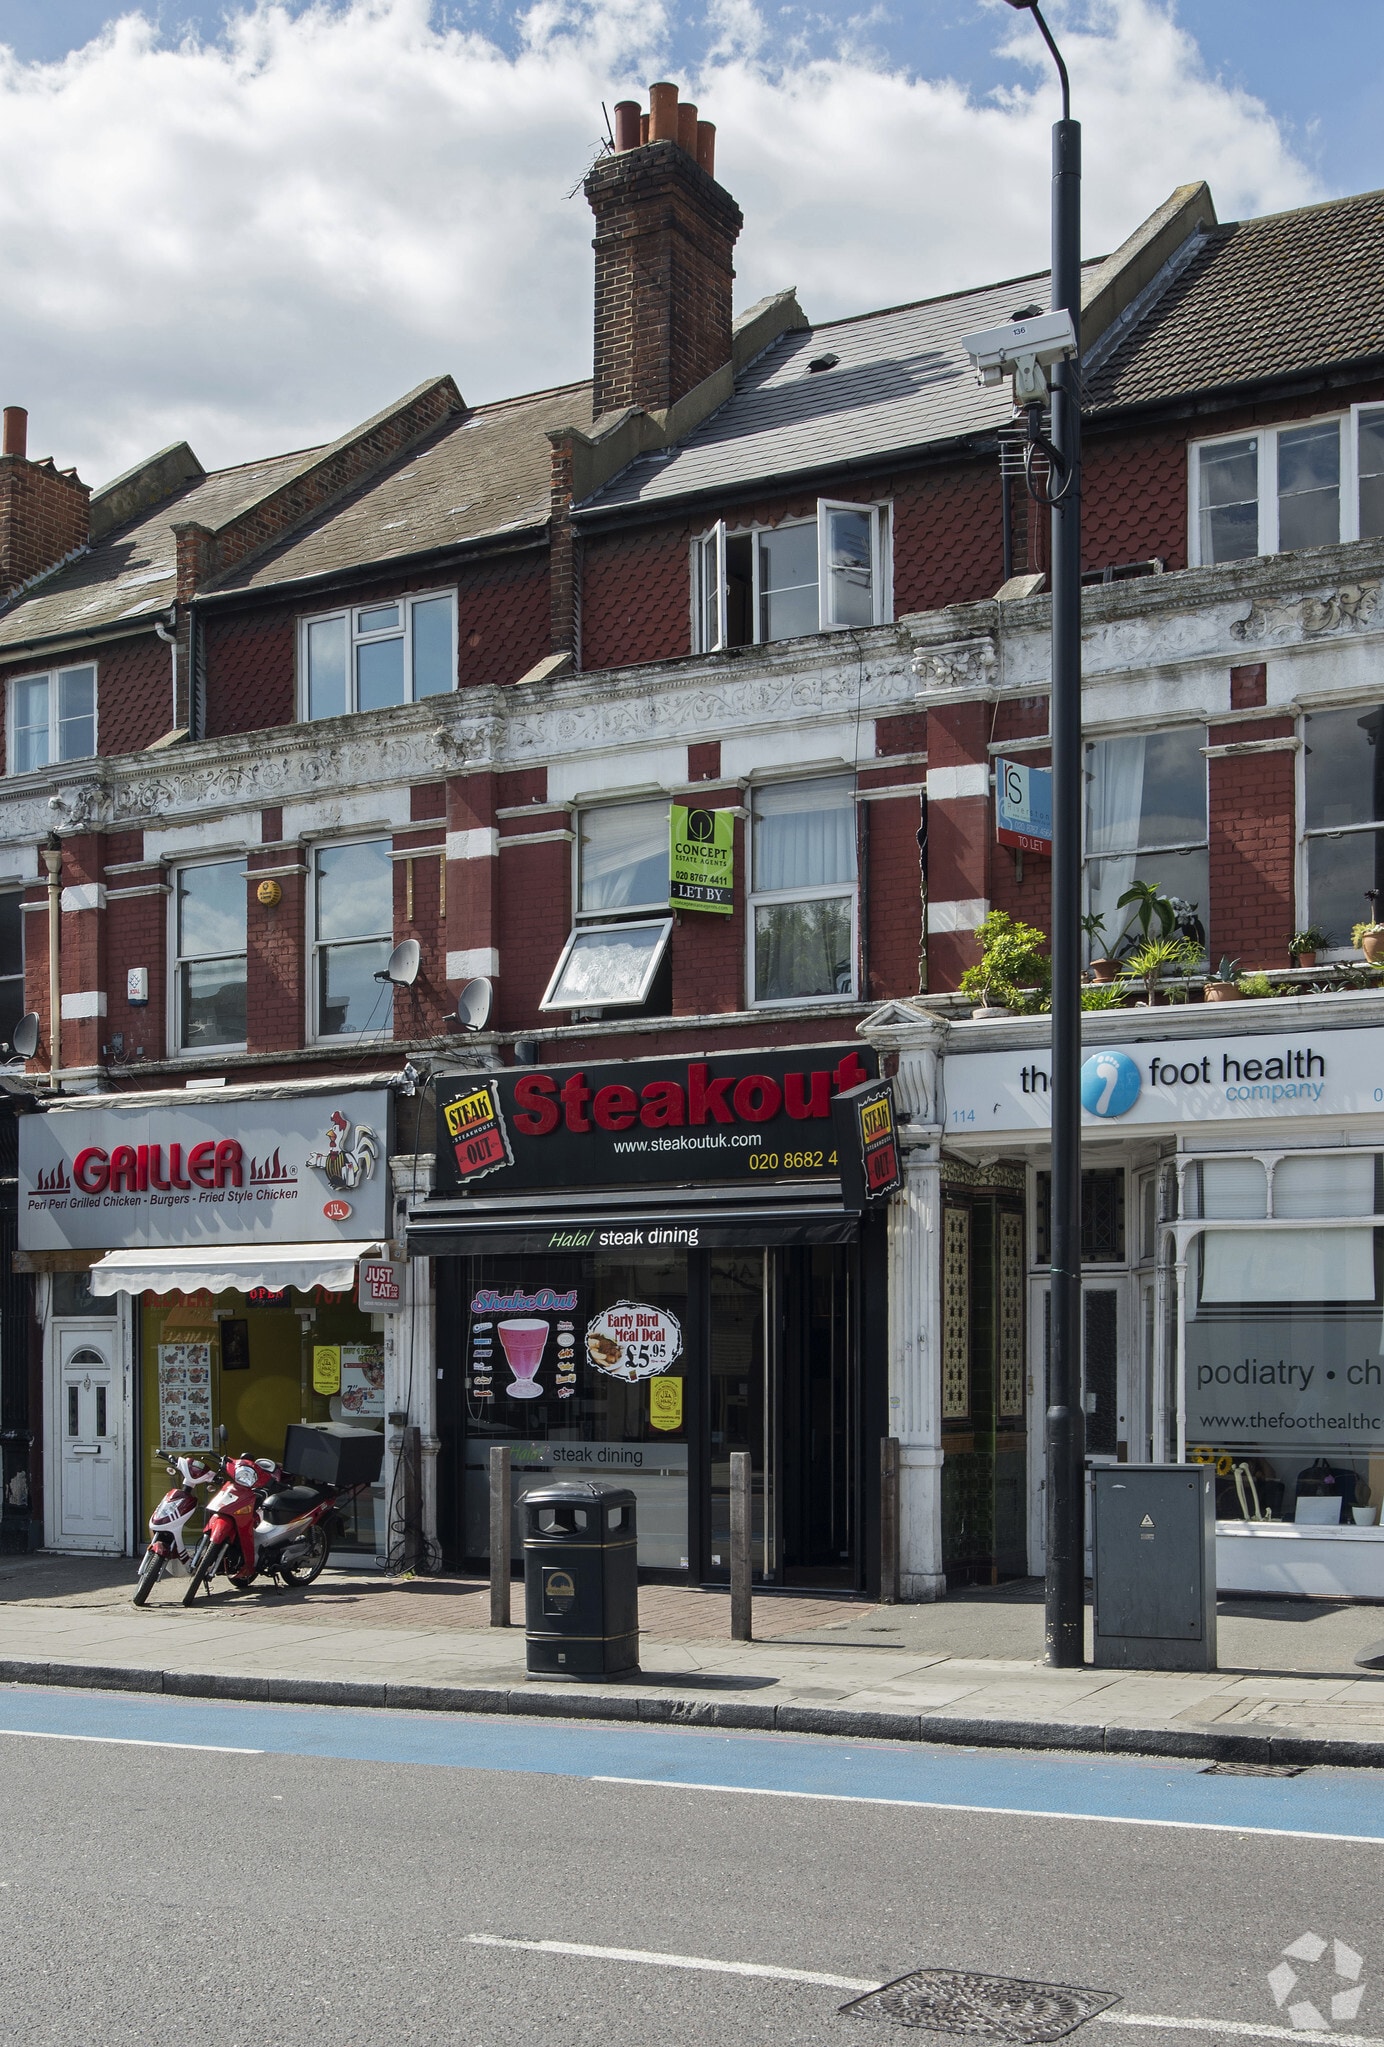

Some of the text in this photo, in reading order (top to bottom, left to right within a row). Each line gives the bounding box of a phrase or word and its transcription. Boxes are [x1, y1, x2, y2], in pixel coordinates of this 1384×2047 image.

[1013, 327, 1026, 335] 136
[1007, 802, 1050, 820] Riverston
[675, 843, 728, 859] CONCEPT
[1018, 836, 1043, 851] TO LET
[675, 855, 727, 867] ESTATE AGENTS
[675, 870, 727, 885] 020 8767 4411
[679, 884, 724, 901] LET BY
[1020, 1048, 1325, 1093] th foot health
[513, 1052, 867, 1136] Steakout
[1225, 1082, 1325, 1103] company
[449, 1095, 491, 1131] STEAK
[864, 1105, 889, 1138] STEAK
[952, 1109, 976, 1123] 114
[466, 1137, 493, 1164] OUT
[614, 1133, 762, 1153] www.steakoutuk.com
[72, 1138, 243, 1194] GRILLER
[749, 1153, 779, 1170] 020
[784, 1151, 823, 1168] 8682
[874, 1152, 890, 1180] OUT
[28, 1189, 298, 1210] Peri Peri Grilled Chicken Burgers Fried Style Chicken
[547, 1226, 699, 1248] Halal steak dining
[366, 1267, 393, 1283] JUST
[471, 1289, 577, 1313] ShakeOut
[608, 1313, 659, 1329] Early Bird
[615, 1328, 665, 1342] Meal Deal
[625, 1344, 666, 1368] £5.95
[1197, 1359, 1315, 1391] podiatry
[1199, 1412, 1384, 1430] www.thefoothealthc
[553, 1447, 593, 1462] steak
[597, 1448, 643, 1467] dining
